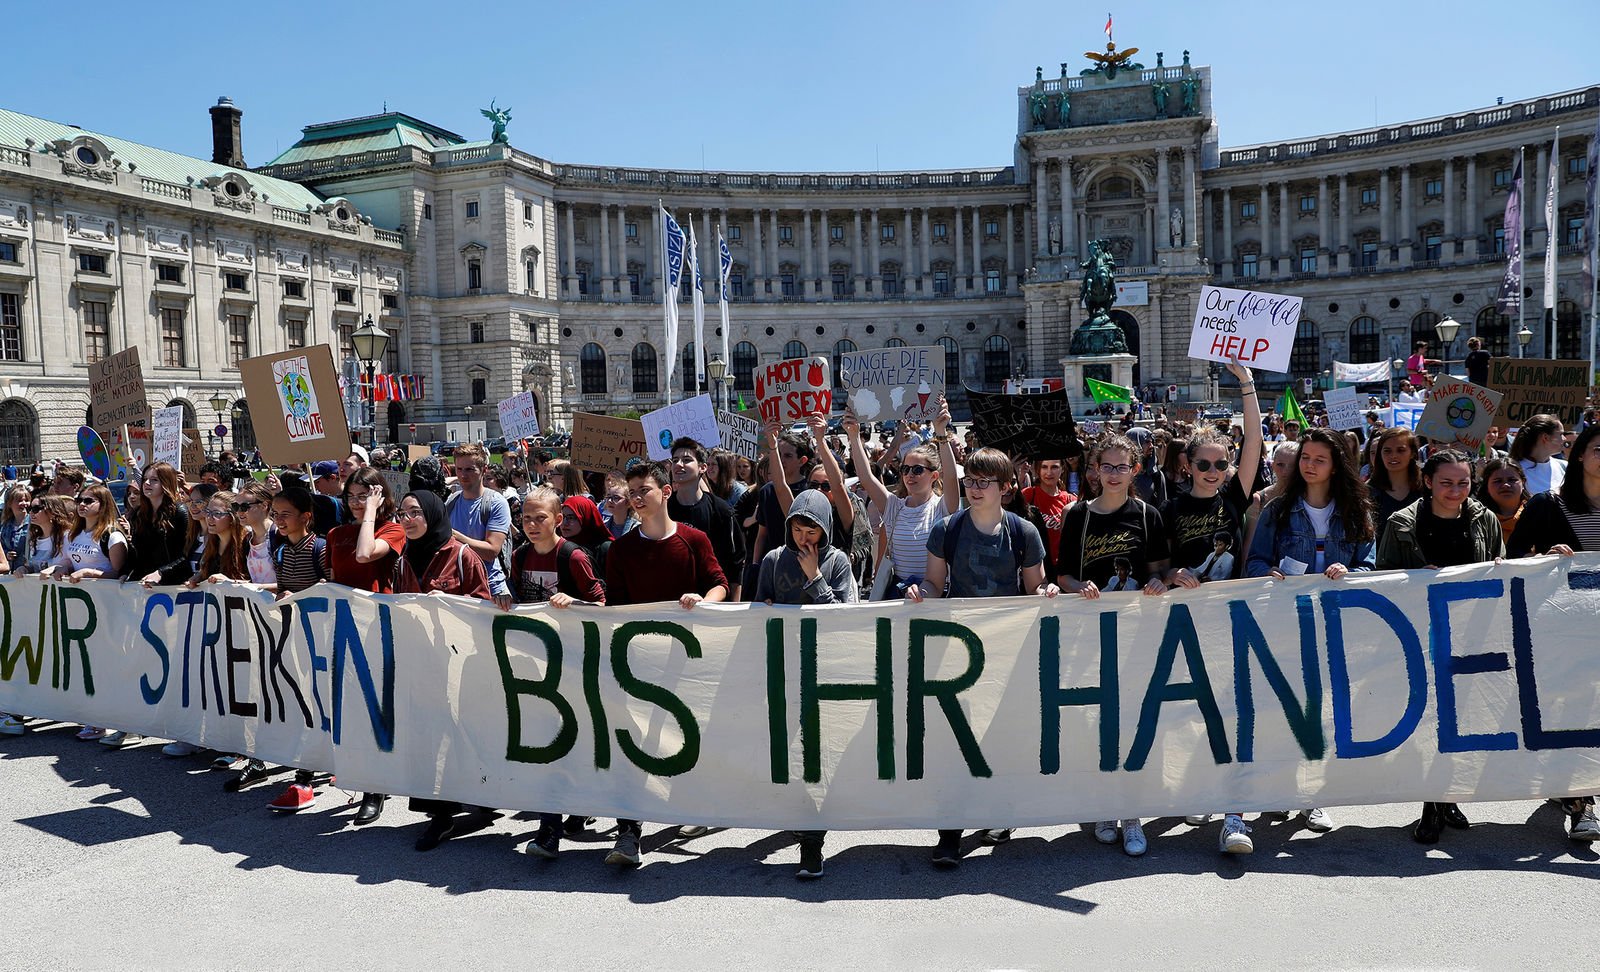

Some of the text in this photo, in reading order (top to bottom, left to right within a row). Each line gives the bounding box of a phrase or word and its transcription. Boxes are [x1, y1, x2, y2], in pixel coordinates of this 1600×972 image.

[1206, 289, 1235, 311] Our
[1200, 314, 1237, 333] needs
[1210, 334, 1270, 361] HELP
[101, 351, 136, 376] ICH WILL
[767, 359, 803, 386] HOT
[1492, 361, 1588, 387] KLIMAWANDEL
[92, 376, 113, 395] NICHT
[776, 382, 792, 393] BUT
[843, 368, 944, 389] SCHMELZEN
[96, 382, 142, 406] DIE MATURA
[1433, 384, 1496, 416] MAKE THE EARTH
[97, 405, 127, 426] GEMACHT
[522, 406, 534, 418] NOT
[759, 389, 832, 424] NOT SEXY
[286, 413, 324, 438] CLIMATE
[619, 440, 646, 456] NOT
[719, 430, 758, 460] KLIMATET
[0, 569, 1600, 784] WIR STREIKEN BIS IHR HANDEL
